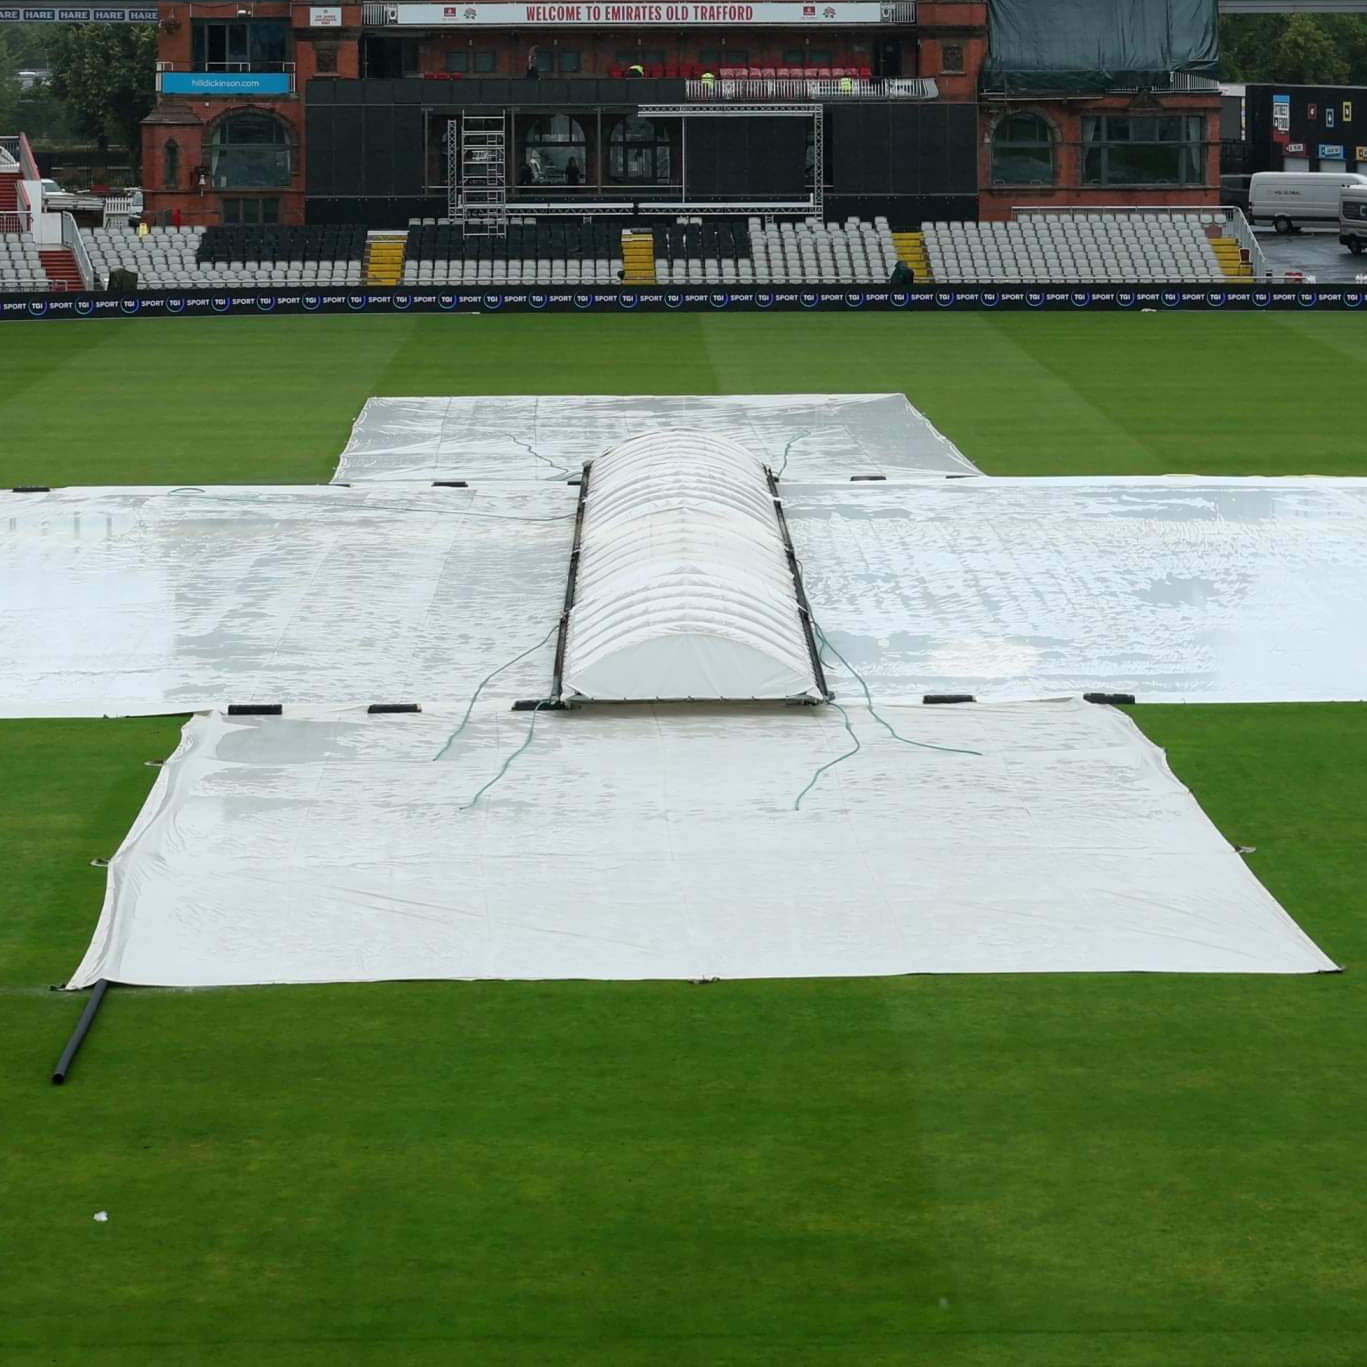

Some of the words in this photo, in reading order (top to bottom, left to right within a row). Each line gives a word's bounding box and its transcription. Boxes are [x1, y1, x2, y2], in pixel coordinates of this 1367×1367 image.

[25, 10, 53, 20] HARE
[60, 10, 89, 20] HARE
[95, 10, 123, 20] HARE
[526, 5, 582, 21] WELCOME
[585, 5, 601, 21] TO
[605, 5, 662, 21] EMIRATES
[666, 5, 689, 21] OLD
[693, 5, 753, 21] TRAFFORD
[232, 297, 255, 305] SPORT
[368, 295, 391, 303] SPORT
[504, 295, 527, 303] SPORT
[640, 294, 662, 302] SPORT
[956, 293, 979, 301] SPORT
[1091, 293, 1114, 301] SPORT
[95, 300, 119, 308] SPORT
